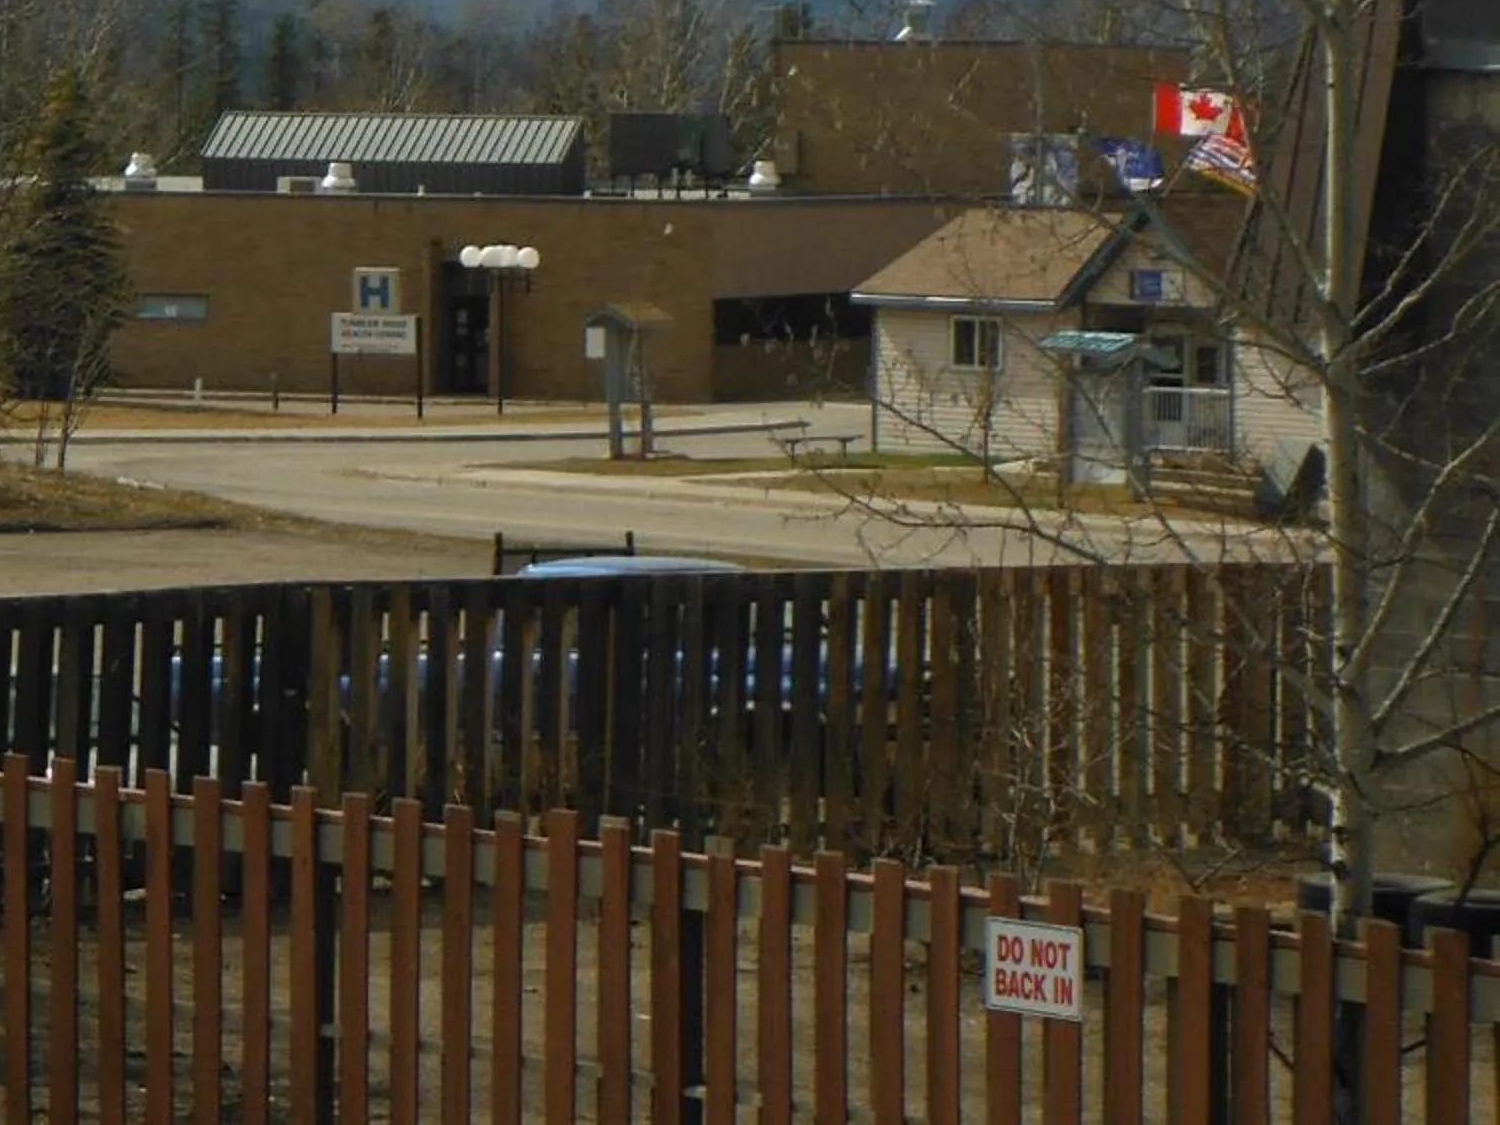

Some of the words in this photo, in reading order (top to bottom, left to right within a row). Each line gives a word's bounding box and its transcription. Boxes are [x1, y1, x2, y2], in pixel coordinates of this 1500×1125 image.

[996, 935, 1024, 965] DO
[1030, 938, 1071, 971] NOT
[995, 967, 1047, 1003] BACK
[1054, 976, 1073, 1005] IN
